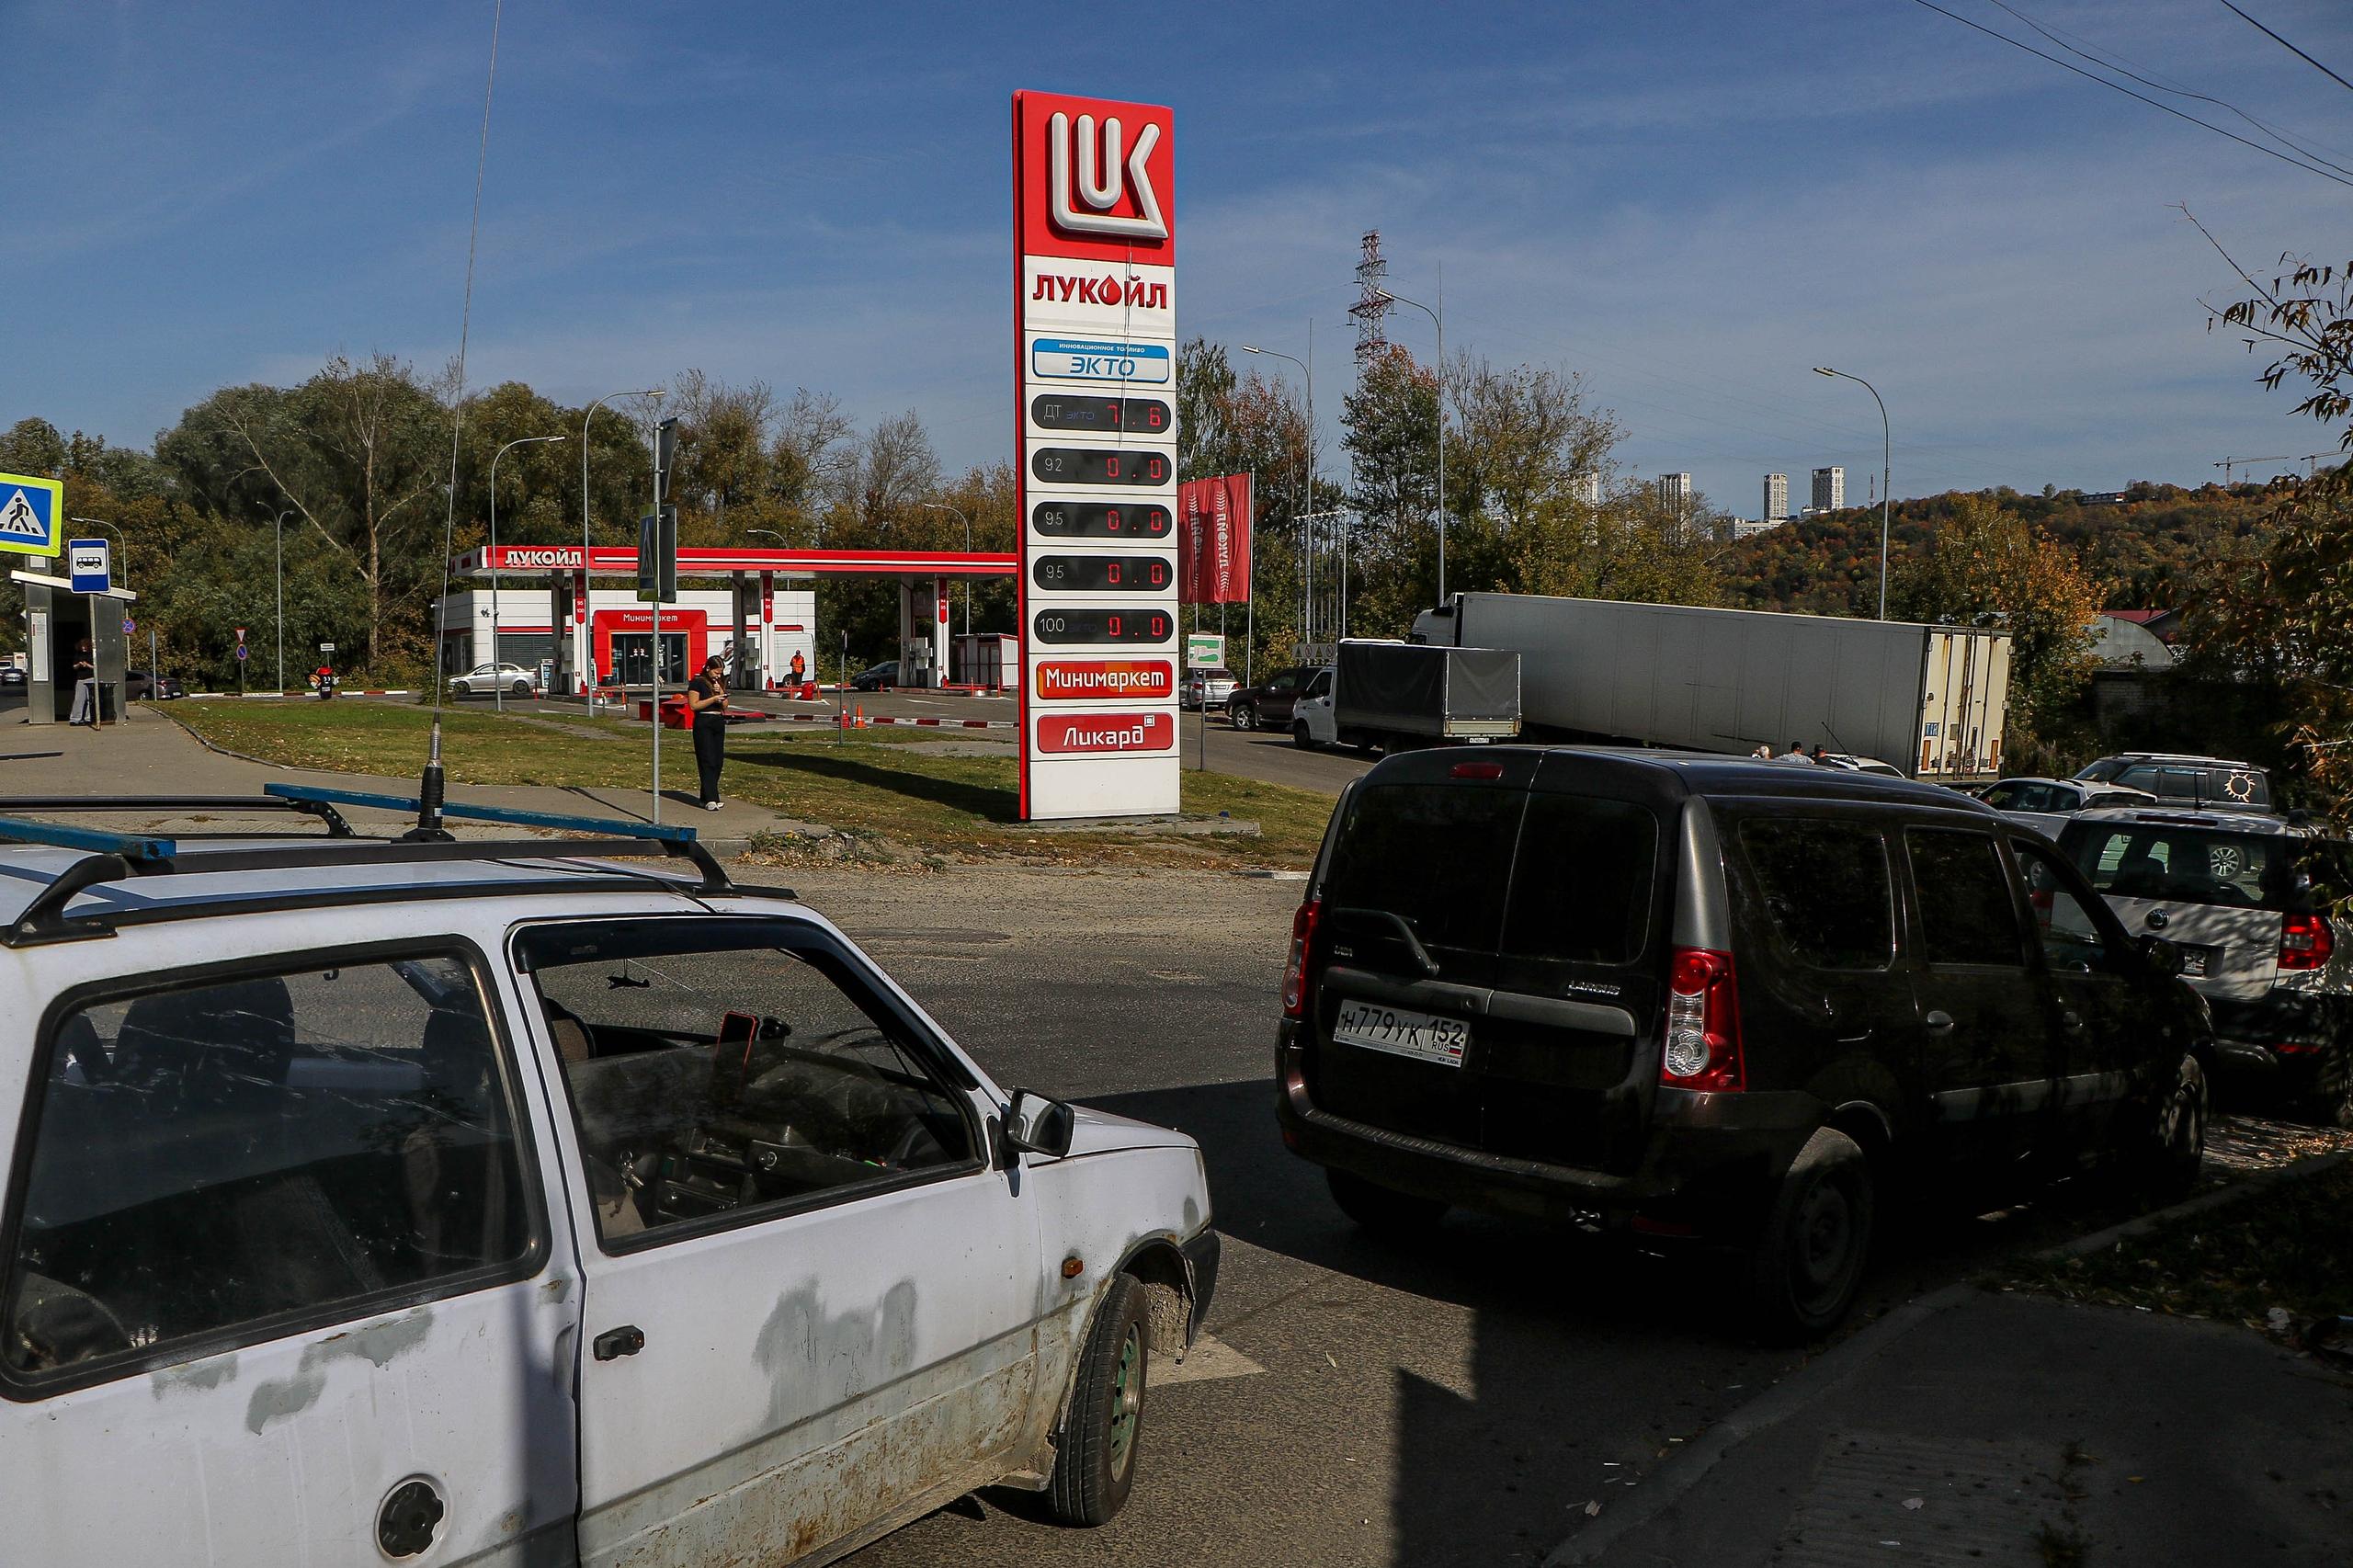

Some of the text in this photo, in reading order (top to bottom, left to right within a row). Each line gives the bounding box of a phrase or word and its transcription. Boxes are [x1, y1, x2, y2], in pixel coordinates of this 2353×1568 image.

[1032, 274, 1167, 310] ЛУКОЙЛ
[1059, 343, 1114, 352] ИННОВАЦИОННОЕ
[1070, 357, 1136, 377] ЭКТО
[1043, 404, 1063, 422] ДТ
[1044, 457, 1063, 472] 92
[1045, 511, 1063, 526] 95
[505, 549, 582, 565] ЛУКОЙЛ
[1046, 564, 1064, 579] 95
[623, 614, 678, 622] Минимкет
[1040, 619, 1064, 632] 100
[1045, 668, 1165, 693] Минимаркет
[1926, 723, 1938, 736] TIR
[1063, 725, 1144, 750] Ликард
[1342, 1006, 1464, 1046] Н779УК 152
[1431, 1040, 1449, 1052] RUS
